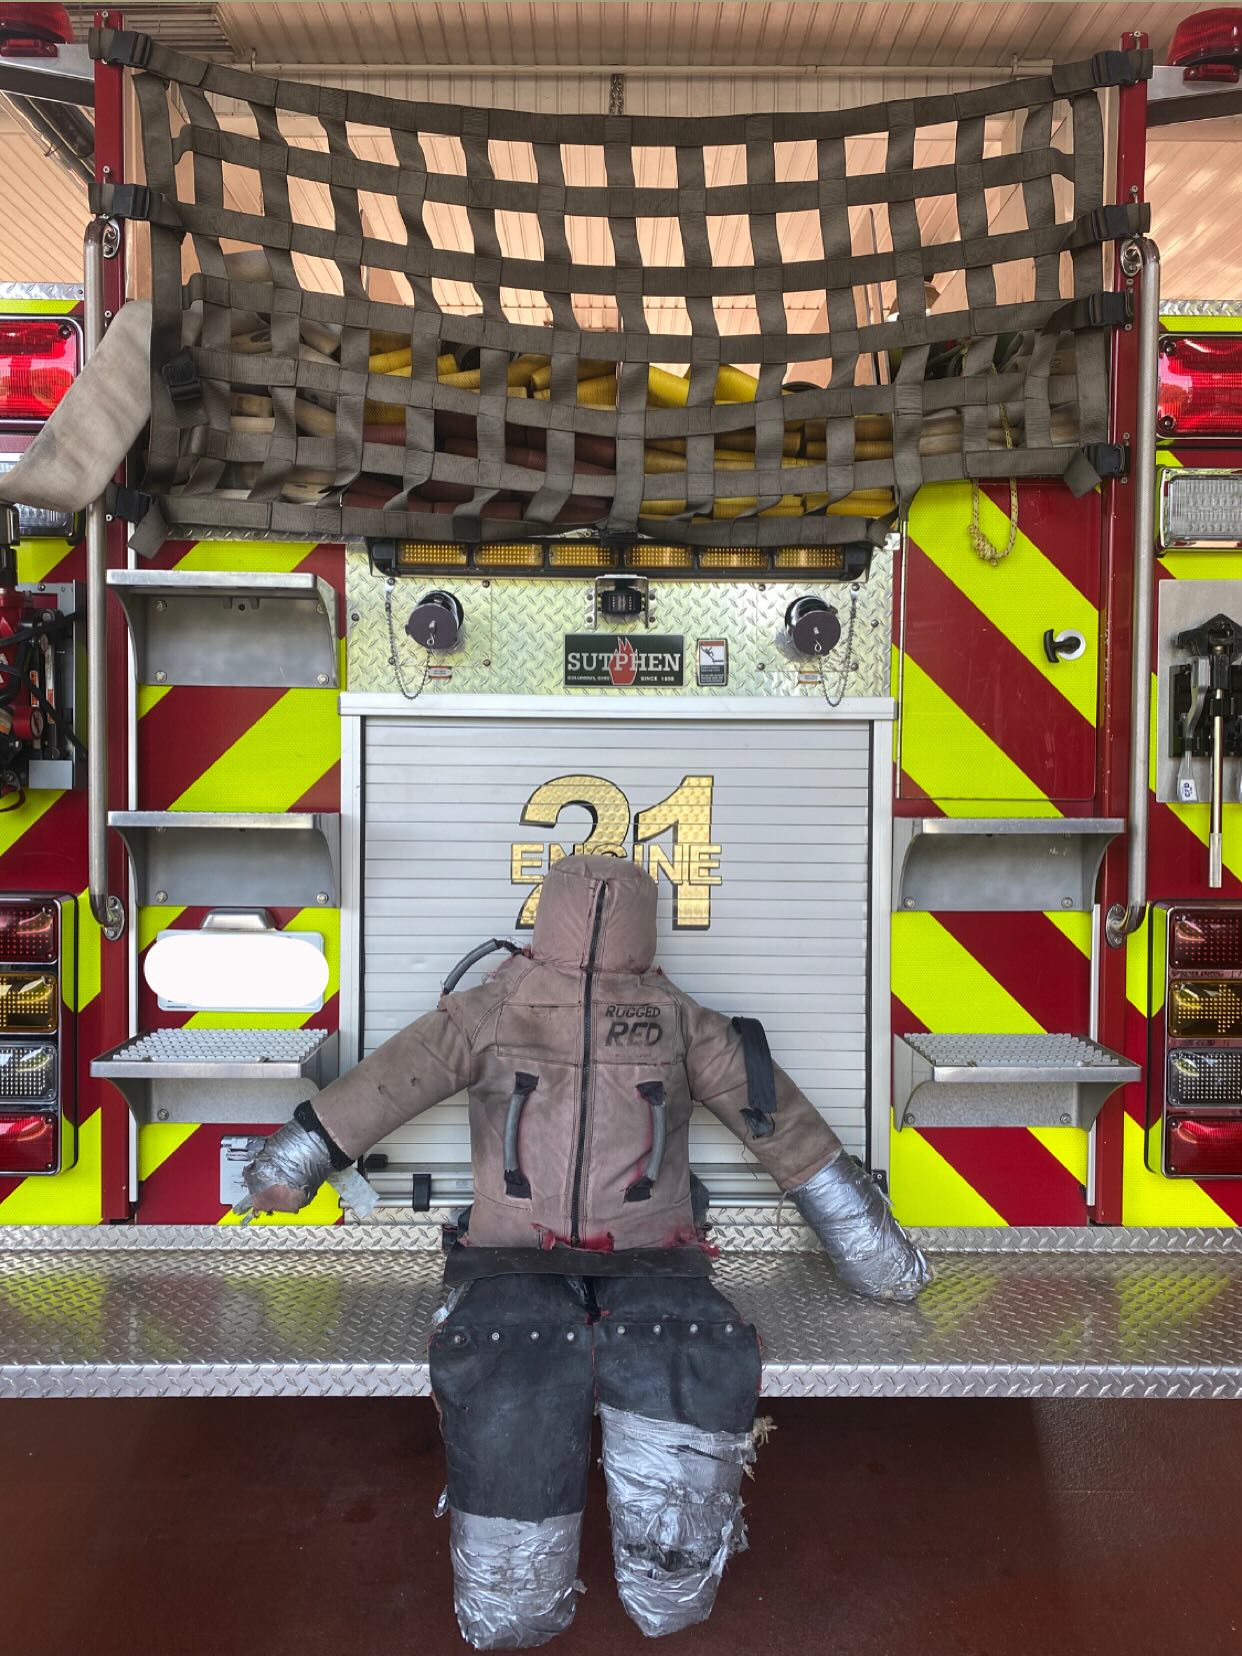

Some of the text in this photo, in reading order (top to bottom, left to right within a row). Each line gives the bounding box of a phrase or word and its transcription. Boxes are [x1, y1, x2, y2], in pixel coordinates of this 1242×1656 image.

[567, 652, 680, 672] SUTPHEN
[511, 843, 722, 885] EINE
[515, 774, 714, 930] 21
[605, 1005, 661, 1018] RUGGED
[605, 1021, 663, 1047] RED
